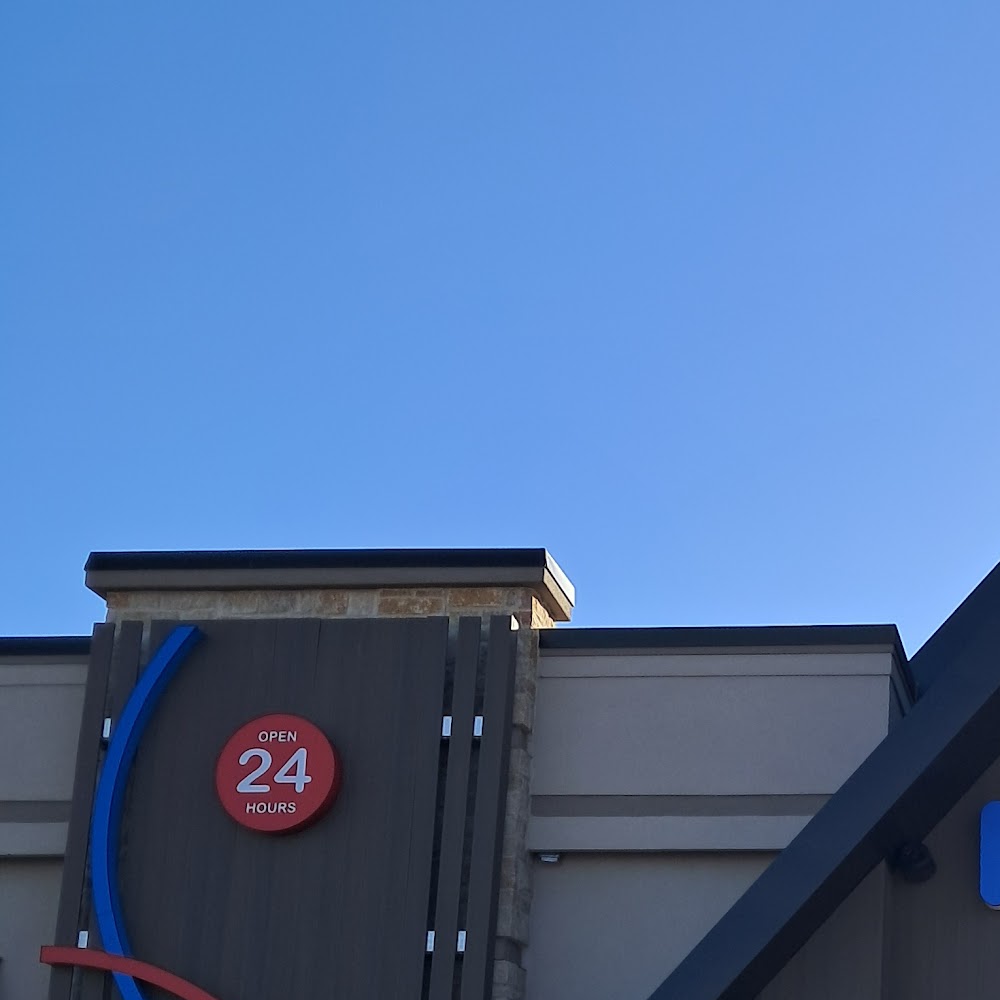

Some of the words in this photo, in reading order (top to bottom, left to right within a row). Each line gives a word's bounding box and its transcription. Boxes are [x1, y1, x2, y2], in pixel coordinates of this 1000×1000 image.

[258, 731, 297, 742] OPEN
[236, 747, 312, 793] 24
[245, 802, 297, 814] HOURS
